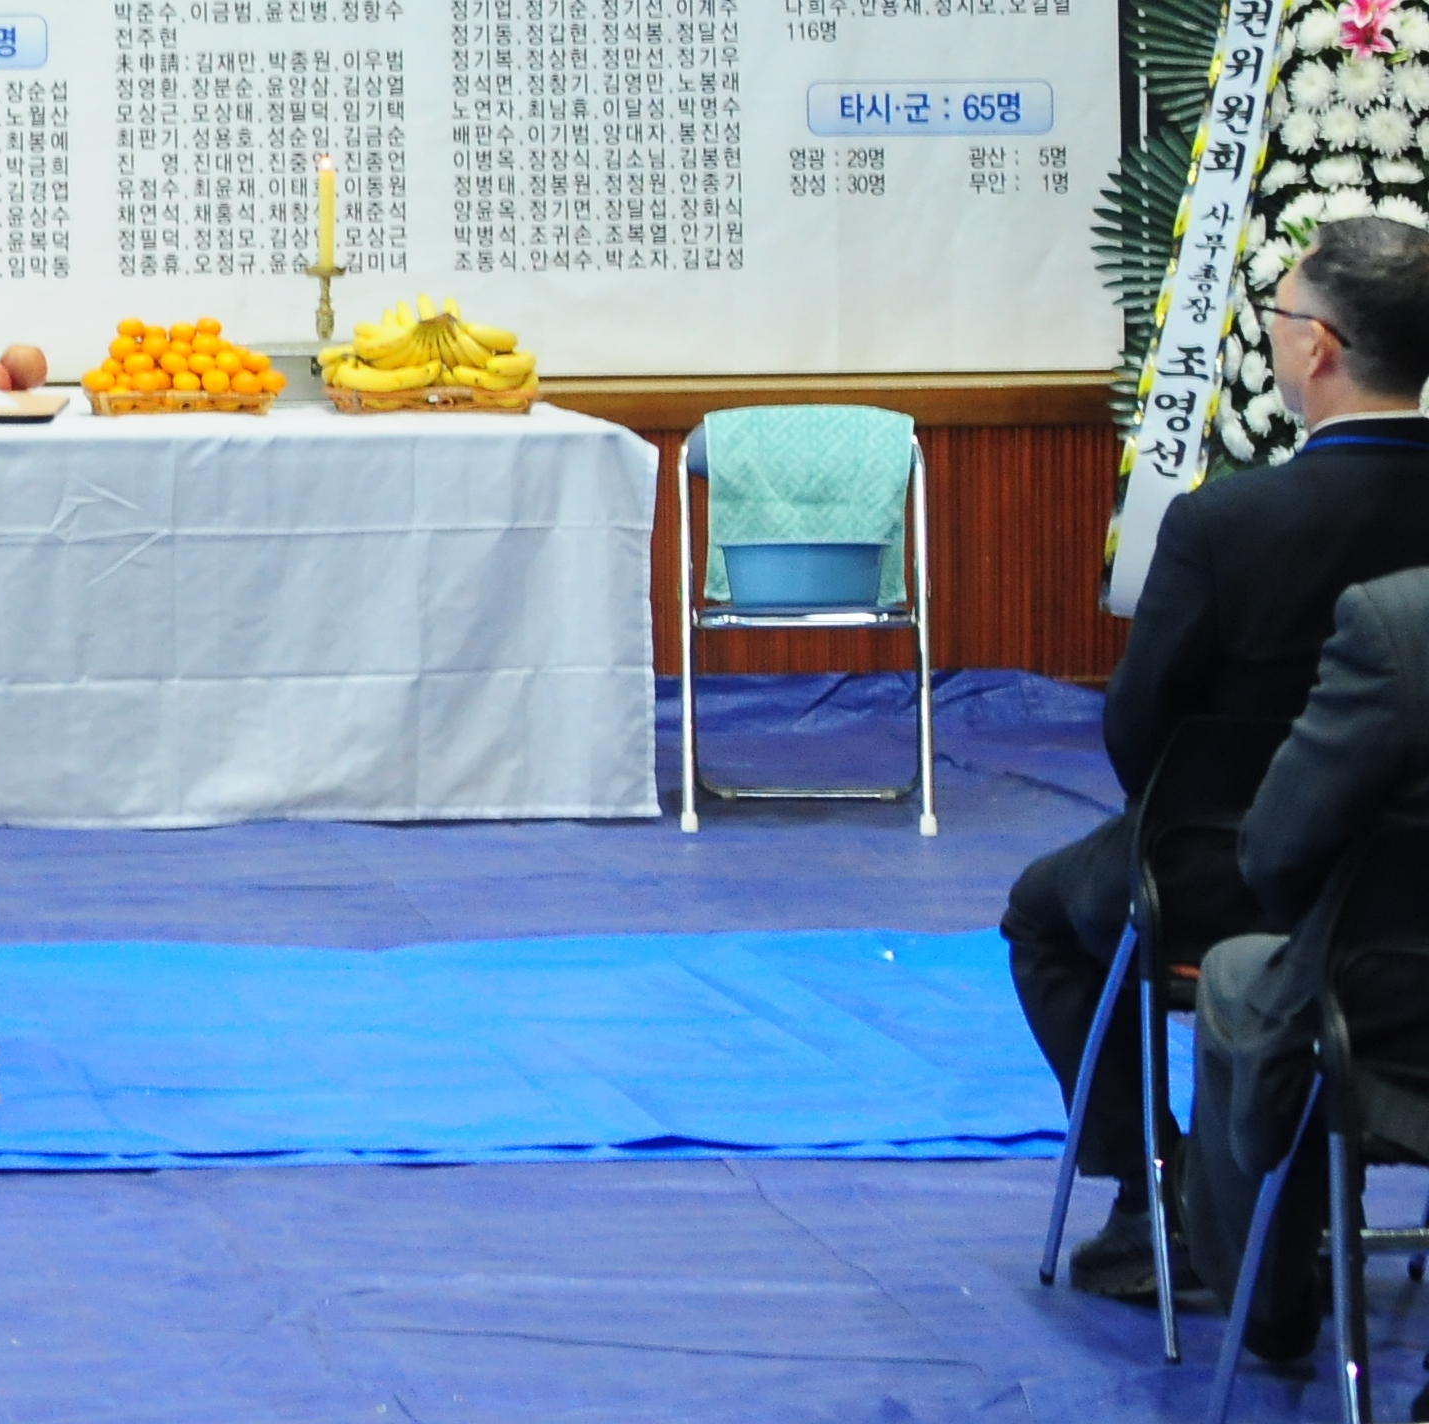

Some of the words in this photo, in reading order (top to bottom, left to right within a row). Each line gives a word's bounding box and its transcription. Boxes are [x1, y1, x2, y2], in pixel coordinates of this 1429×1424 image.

[840, 93, 931, 125] 타시·군
[963, 92, 1021, 123] 65명
[1182, 203, 1234, 325] 사무총장
[1141, 345, 1209, 478] 조영선
